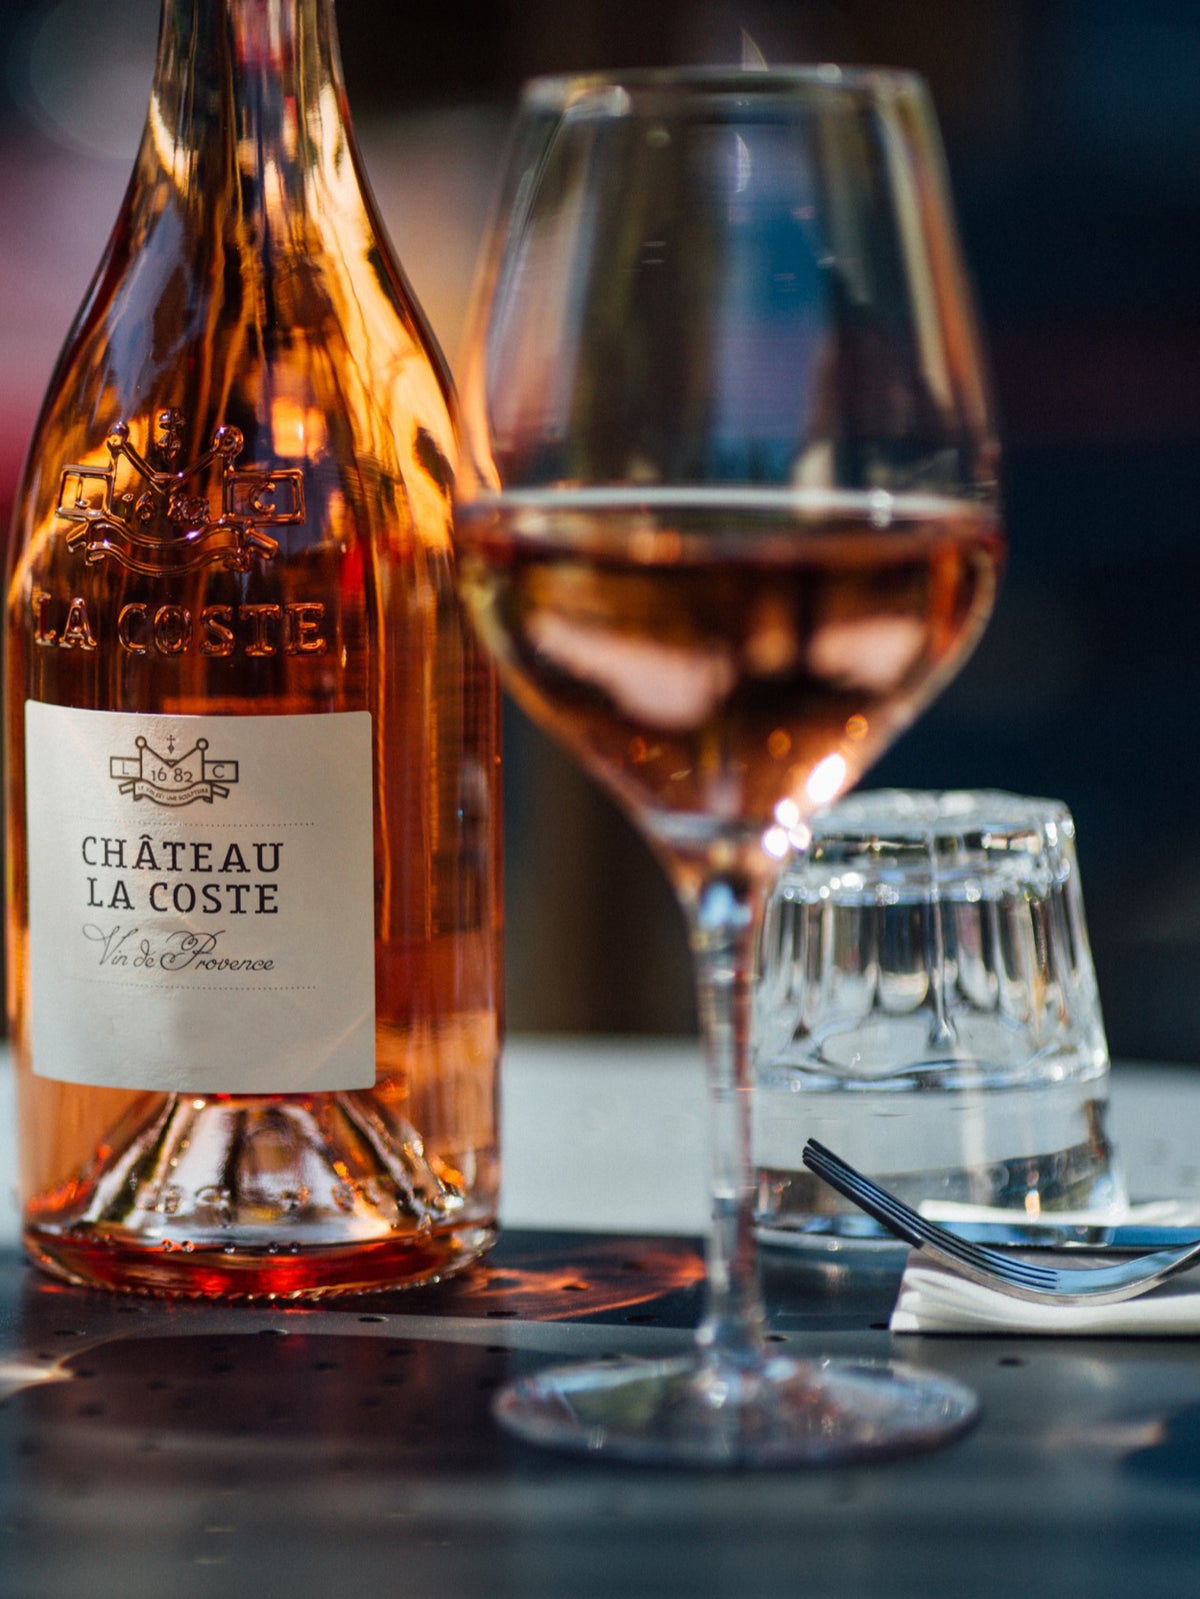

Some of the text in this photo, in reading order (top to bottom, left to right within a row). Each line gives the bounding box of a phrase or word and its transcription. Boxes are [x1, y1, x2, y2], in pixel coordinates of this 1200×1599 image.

[251, 481, 276, 513] C
[33, 590, 328, 657] LA COSTE
[122, 761, 129, 775] L
[212, 764, 225, 778] C
[81, 834, 284, 873] CHÂTEAU
[86, 877, 279, 914] LA COSTE
[82, 923, 275, 971] Vin de Provence
